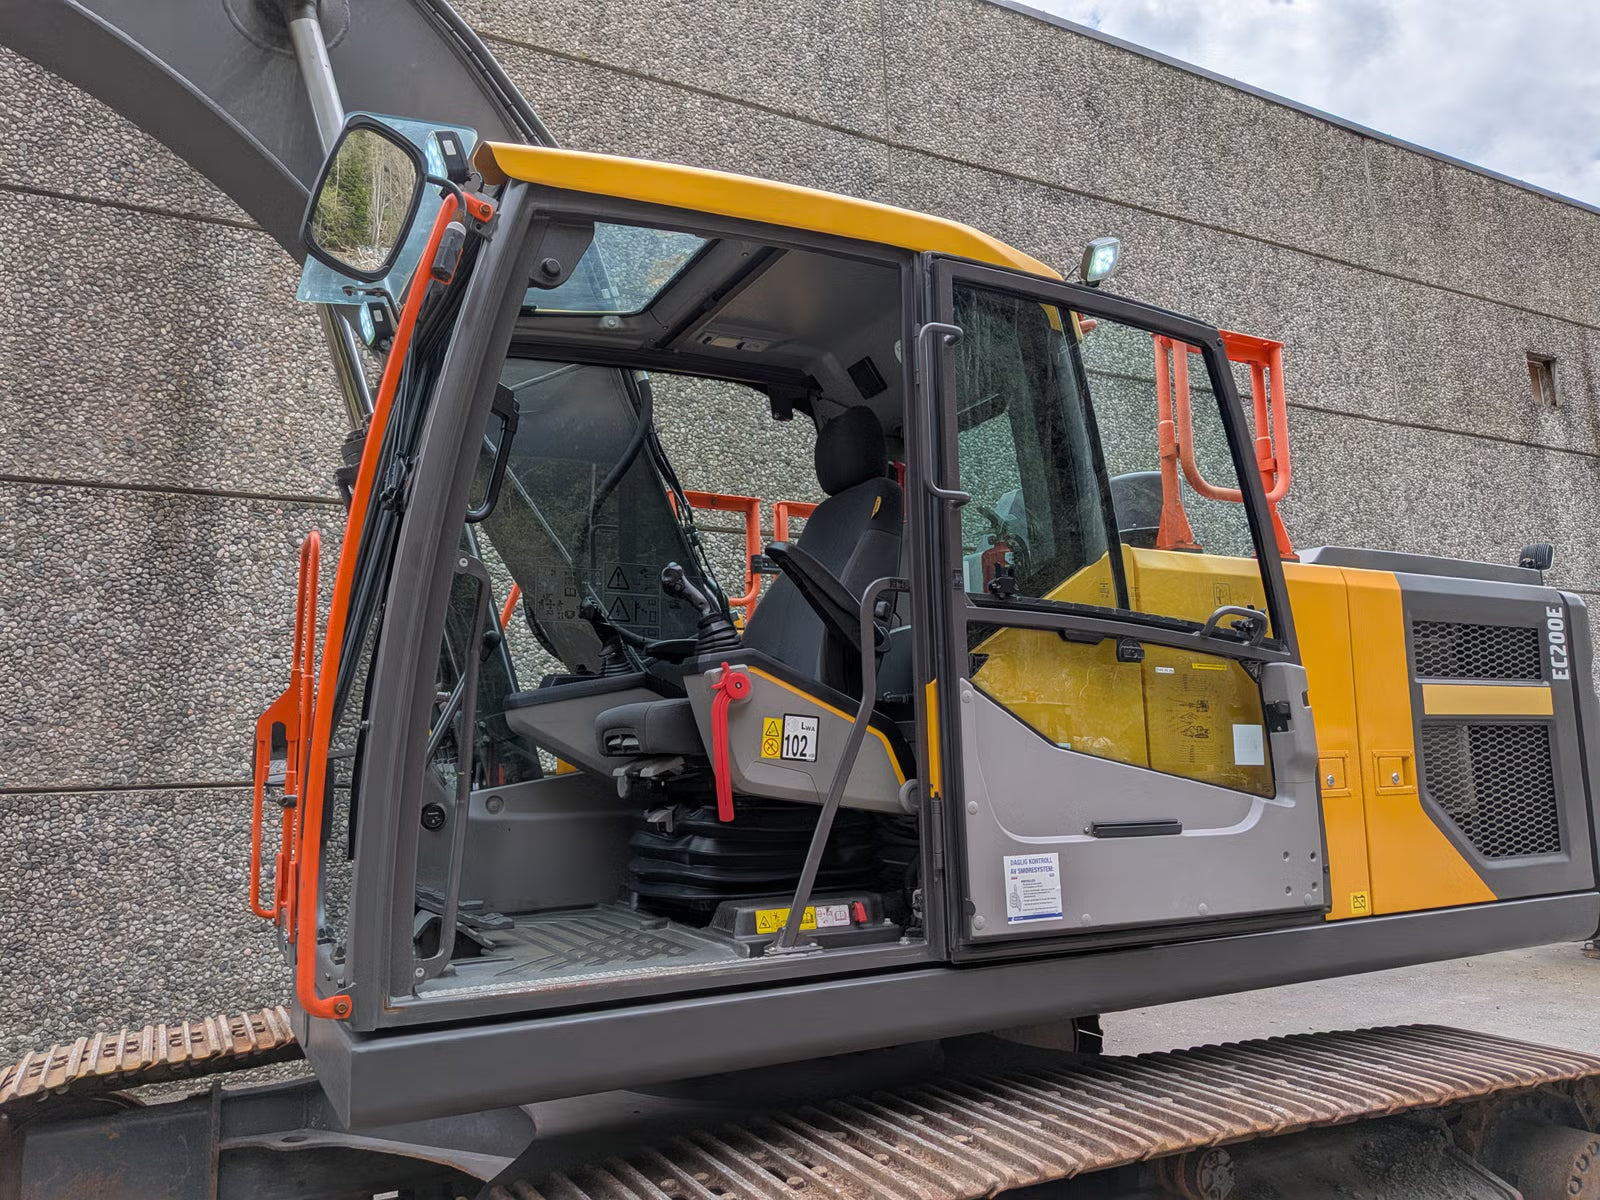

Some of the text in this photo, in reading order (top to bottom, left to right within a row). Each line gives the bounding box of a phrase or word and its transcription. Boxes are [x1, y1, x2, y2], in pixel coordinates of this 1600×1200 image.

[1546, 606, 1569, 680] EC200E
[785, 734, 808, 757] 102
[1010, 857, 1053, 866] DAGLIG KONTROLL
